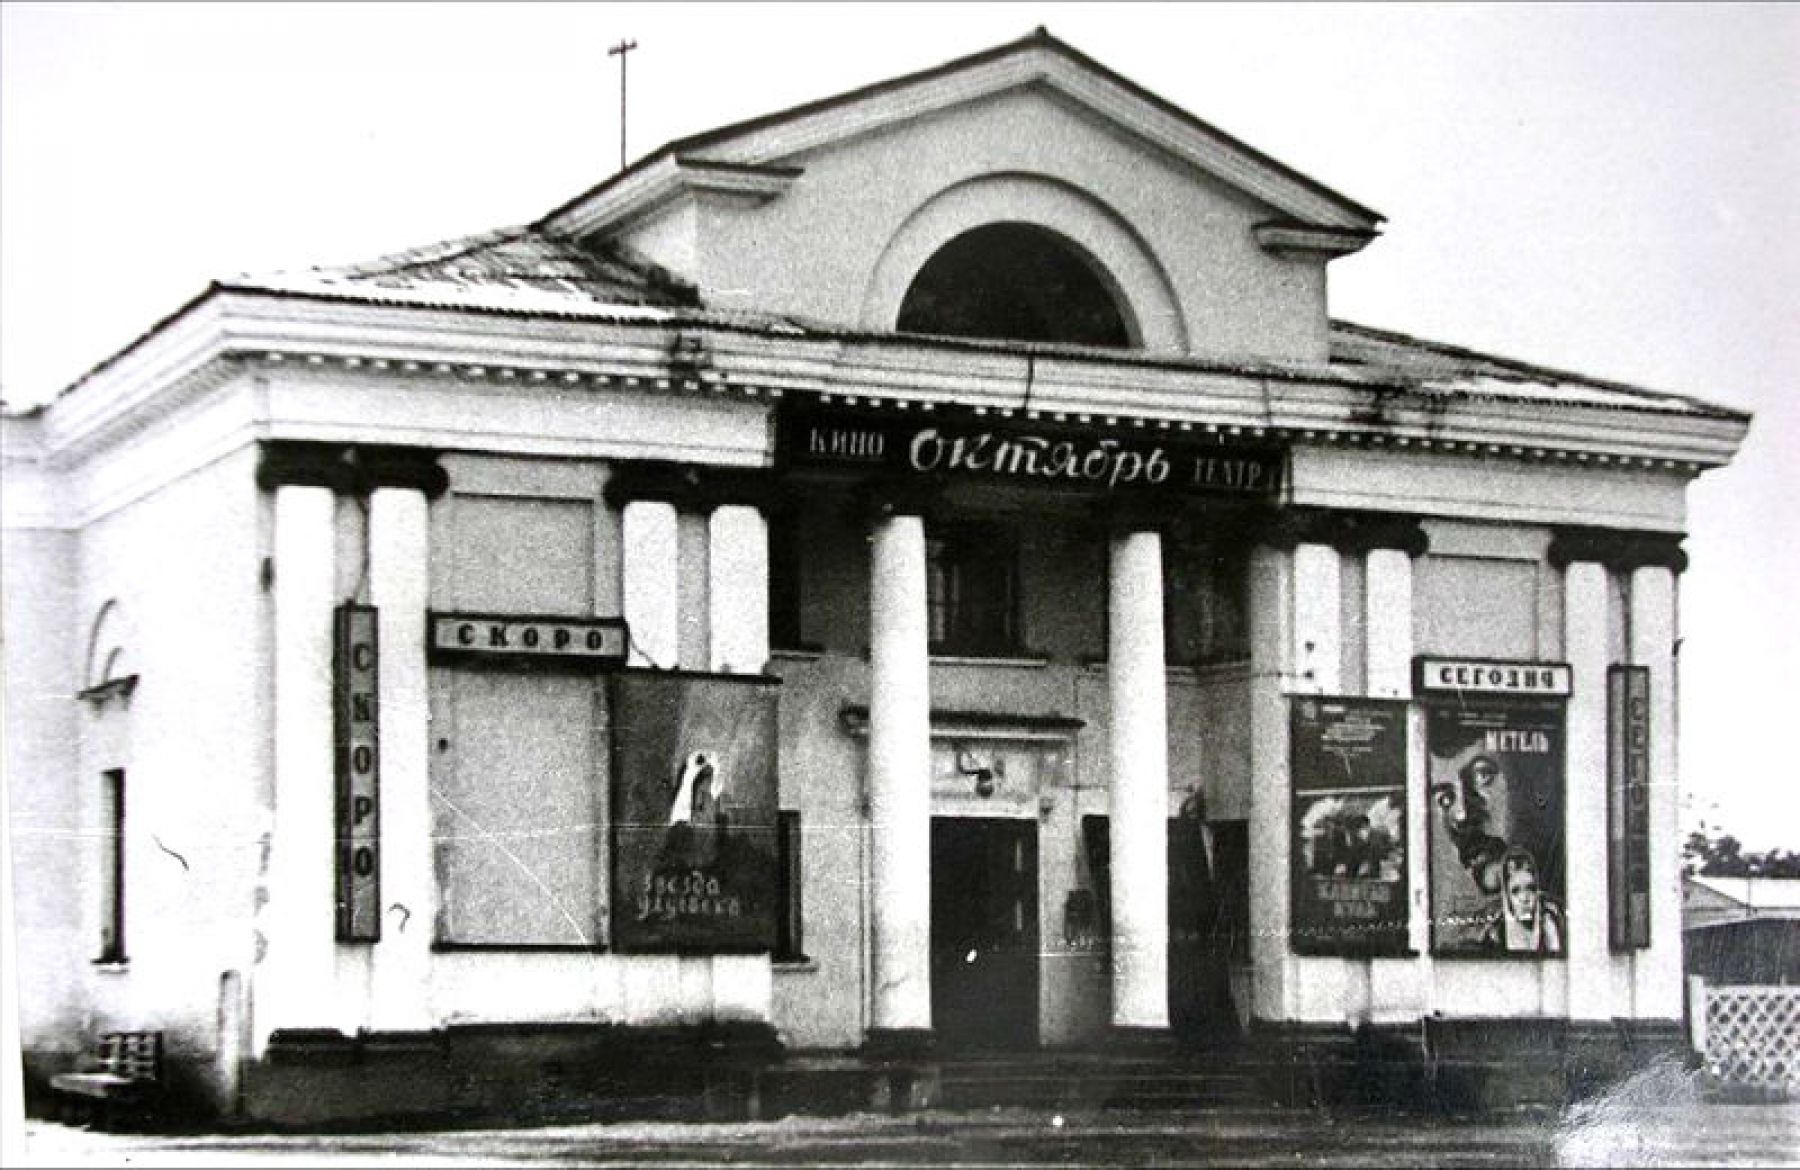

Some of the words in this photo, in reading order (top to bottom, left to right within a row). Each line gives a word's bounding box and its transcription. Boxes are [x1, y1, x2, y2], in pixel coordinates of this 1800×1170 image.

[809, 427, 884, 457] КИНО
[909, 428, 1170, 489] Октябрь
[1193, 457, 1262, 490] ТЕАТР
[458, 622, 604, 651] СКОРО
[353, 642, 373, 876] СКОРО
